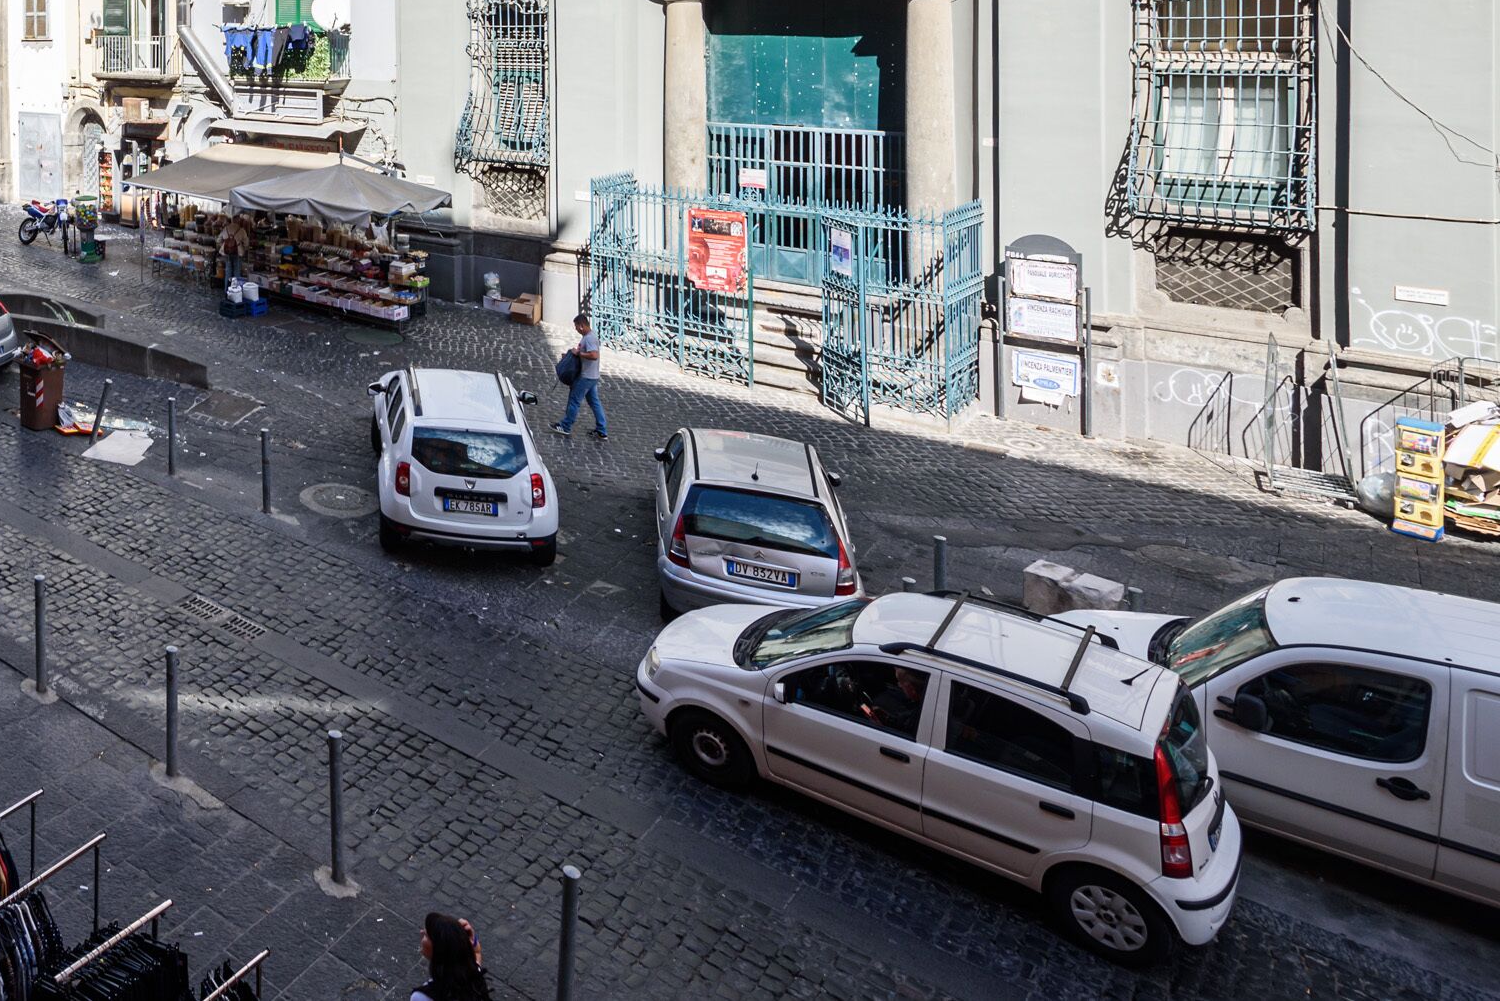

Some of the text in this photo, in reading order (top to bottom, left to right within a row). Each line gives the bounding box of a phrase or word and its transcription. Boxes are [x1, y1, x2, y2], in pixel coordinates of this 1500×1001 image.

[449, 501, 492, 513] EK 785AR
[735, 563, 788, 583] DV 832VA
